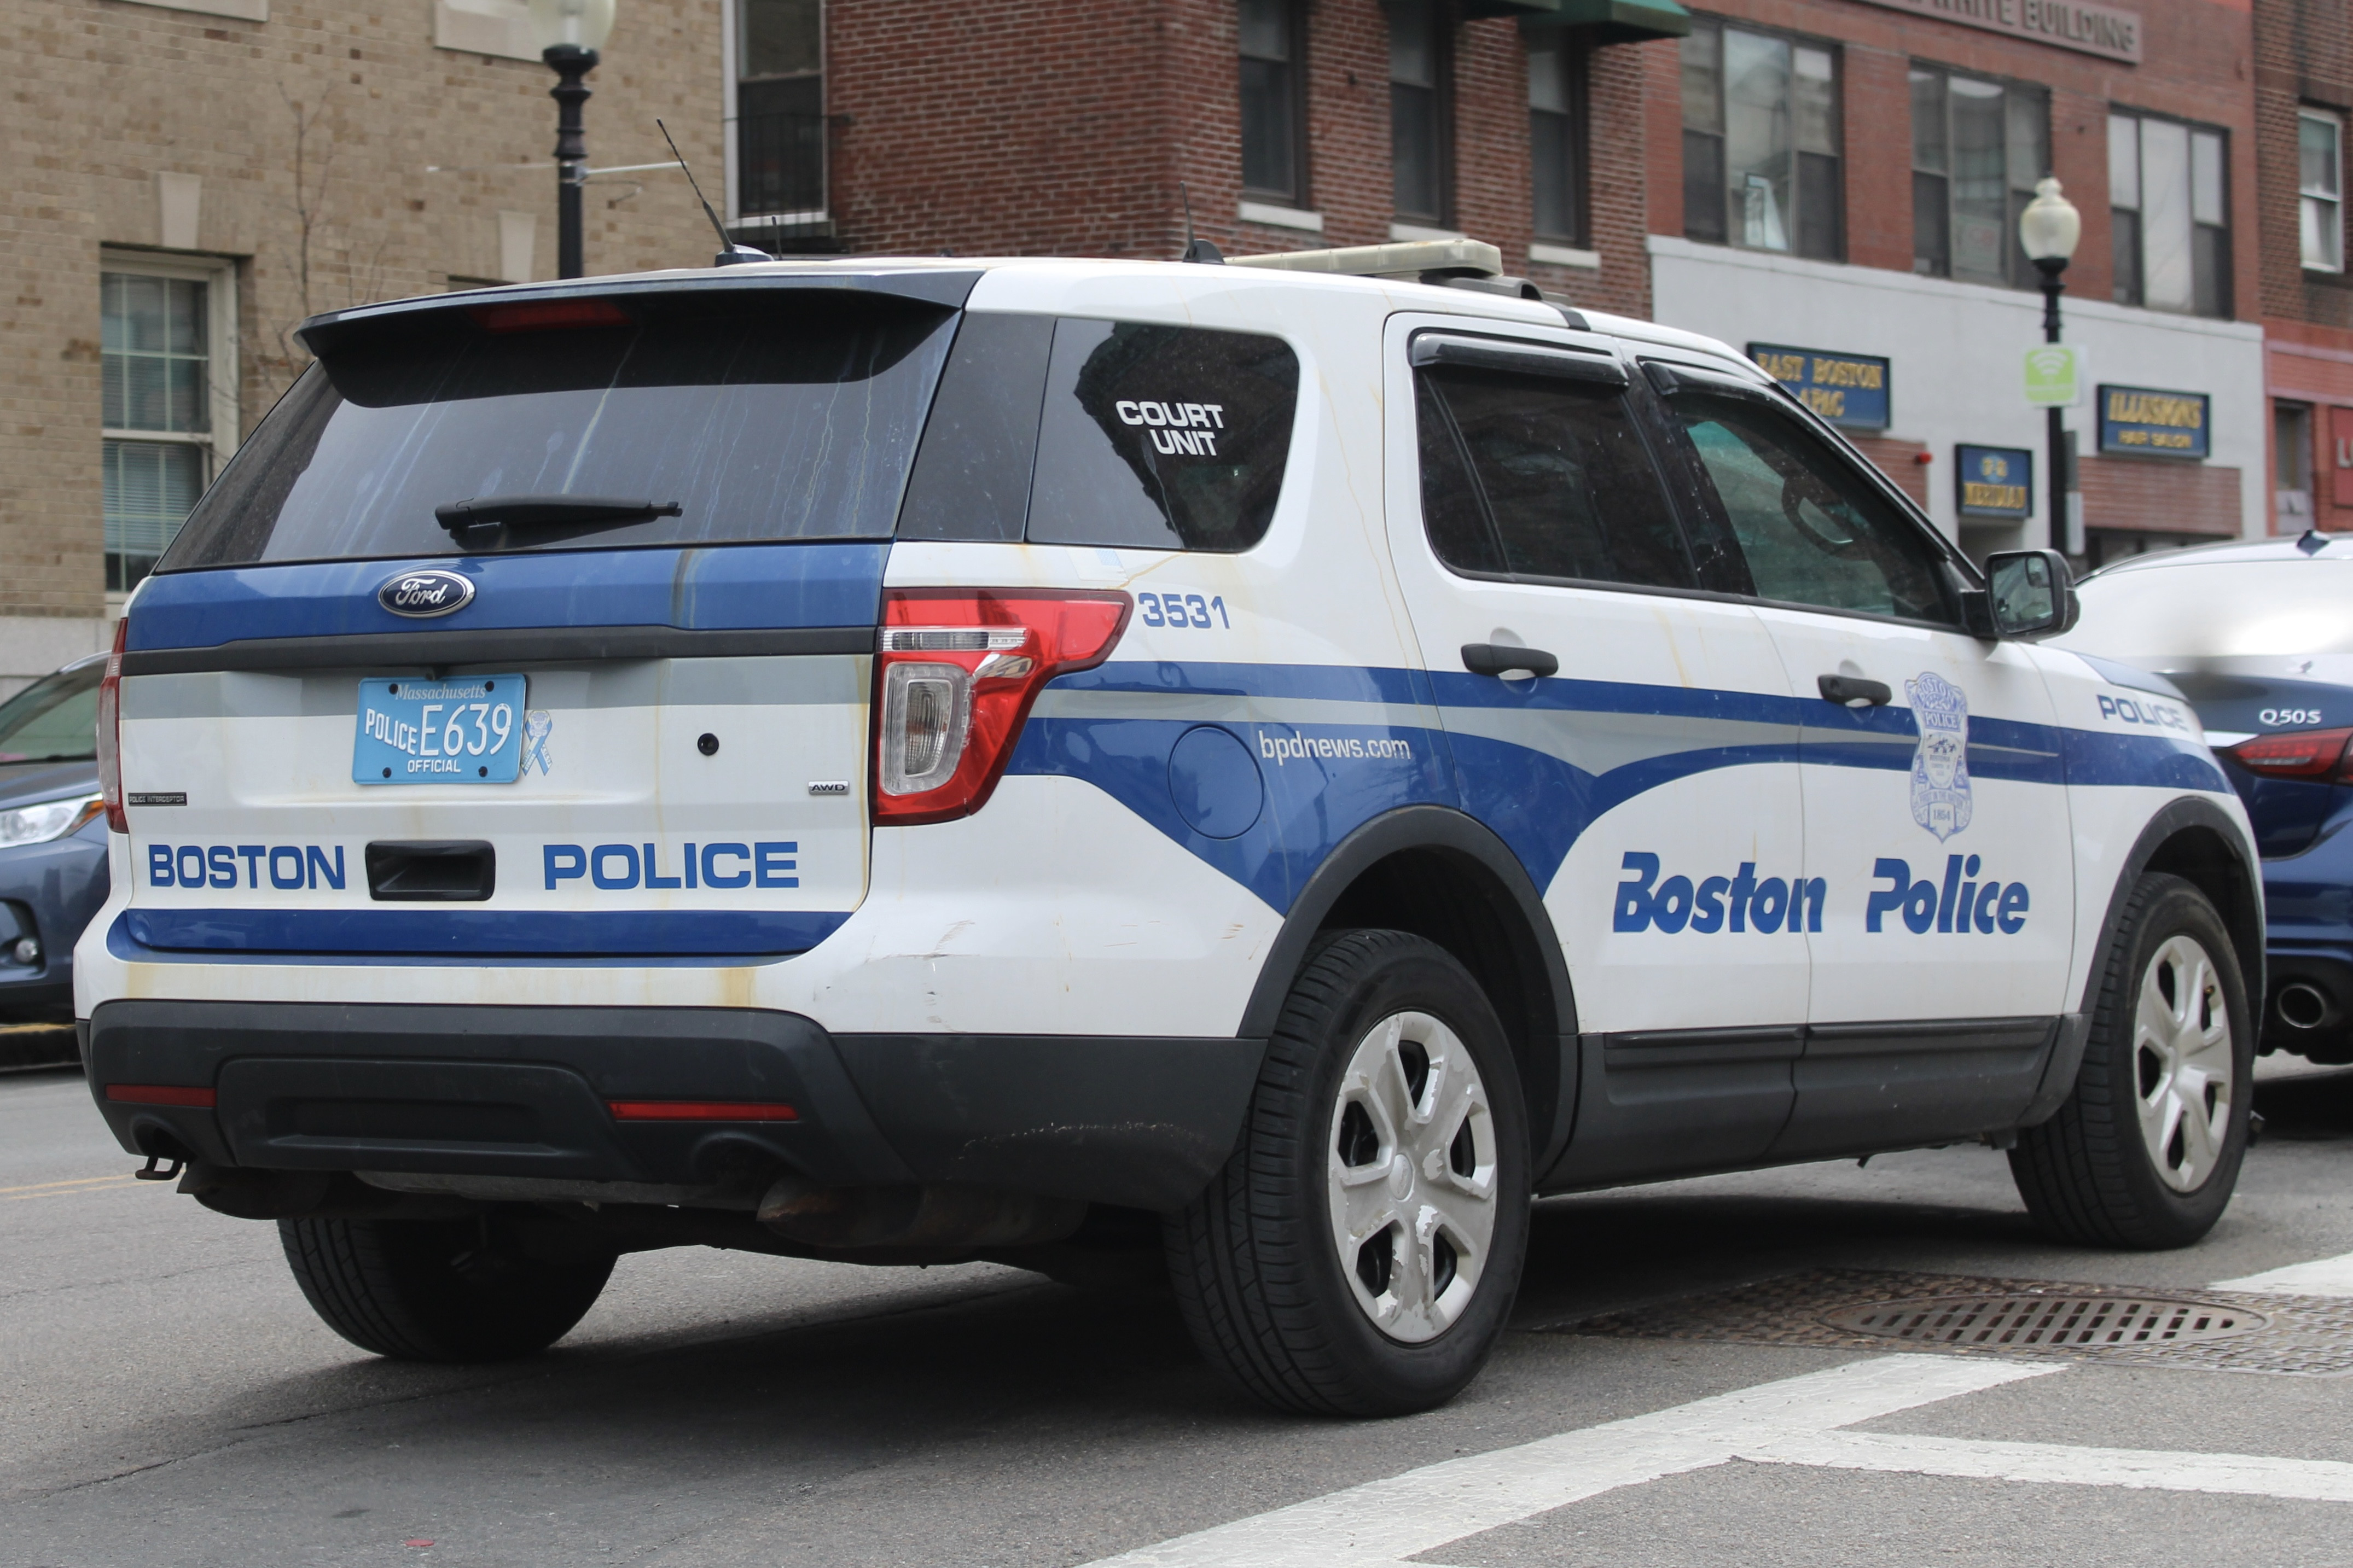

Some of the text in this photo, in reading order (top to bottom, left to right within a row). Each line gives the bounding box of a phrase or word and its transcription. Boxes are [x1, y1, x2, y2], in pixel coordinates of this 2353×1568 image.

[2024, 1, 2137, 53] BUILDING
[1755, 353, 1884, 389] EAST BOSTON
[1116, 400, 1224, 429] COURT
[2108, 392, 2203, 430] ILLUSIONS
[1149, 429, 1217, 456] UNIT
[2151, 432, 2192, 448] SALON
[1963, 482, 2027, 509] MERIDIAN
[395, 578, 449, 606] Ford
[1138, 592, 1230, 629] 3531
[395, 684, 487, 701] Massachusetts
[1916, 678, 1956, 710] BOSTON
[1925, 712, 1958, 728] POLICE
[2096, 693, 2188, 732] POLICE
[2259, 708, 2322, 727] Q50S
[365, 702, 513, 757] POLICE E639
[1258, 730, 1412, 766] bpdnews.com
[407, 759, 462, 773] OFFICIAL
[129, 795, 146, 803] POLICE
[148, 841, 799, 890] BOSTON POLICE
[1612, 851, 2030, 934] Boston Police
